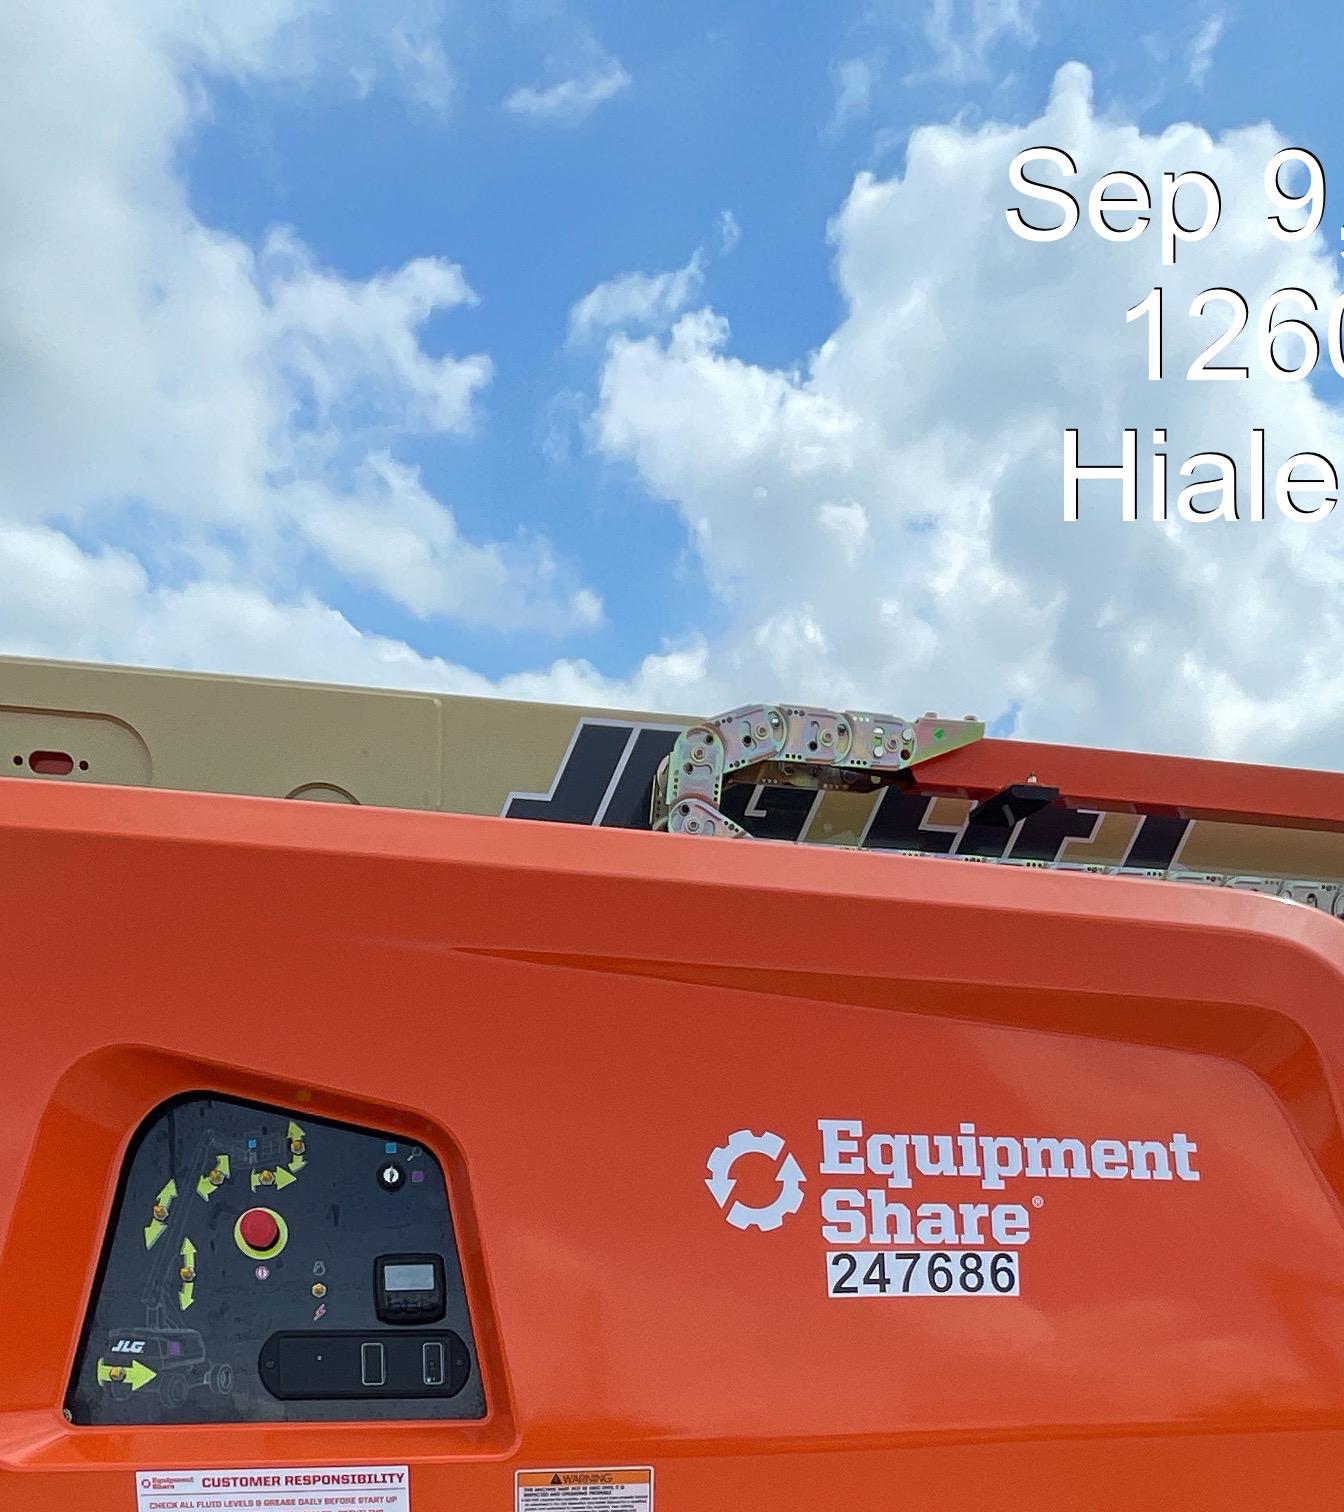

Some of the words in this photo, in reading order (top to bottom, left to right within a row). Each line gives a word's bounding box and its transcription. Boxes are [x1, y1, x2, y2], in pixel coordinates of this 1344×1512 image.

[816, 1118, 1202, 1191] Equipment
[819, 1188, 1032, 1246] Share
[829, 1251, 1017, 1295] 247686
[111, 1339, 146, 1353] JLG
[201, 1476, 281, 1488] CUSTOMER
[285, 1473, 405, 1486] RESPONSIBILITY
[562, 1473, 613, 1484] WARNING
[179, 1501, 195, 1509] ALL
[224, 1500, 254, 1508] LEVELS
[263, 1498, 296, 1507] GREASE
[298, 1498, 322, 1506] DAILY
[324, 1497, 356, 1505] BEFORE
[358, 1496, 384, 1504] START
[386, 1496, 398, 1504] UP
